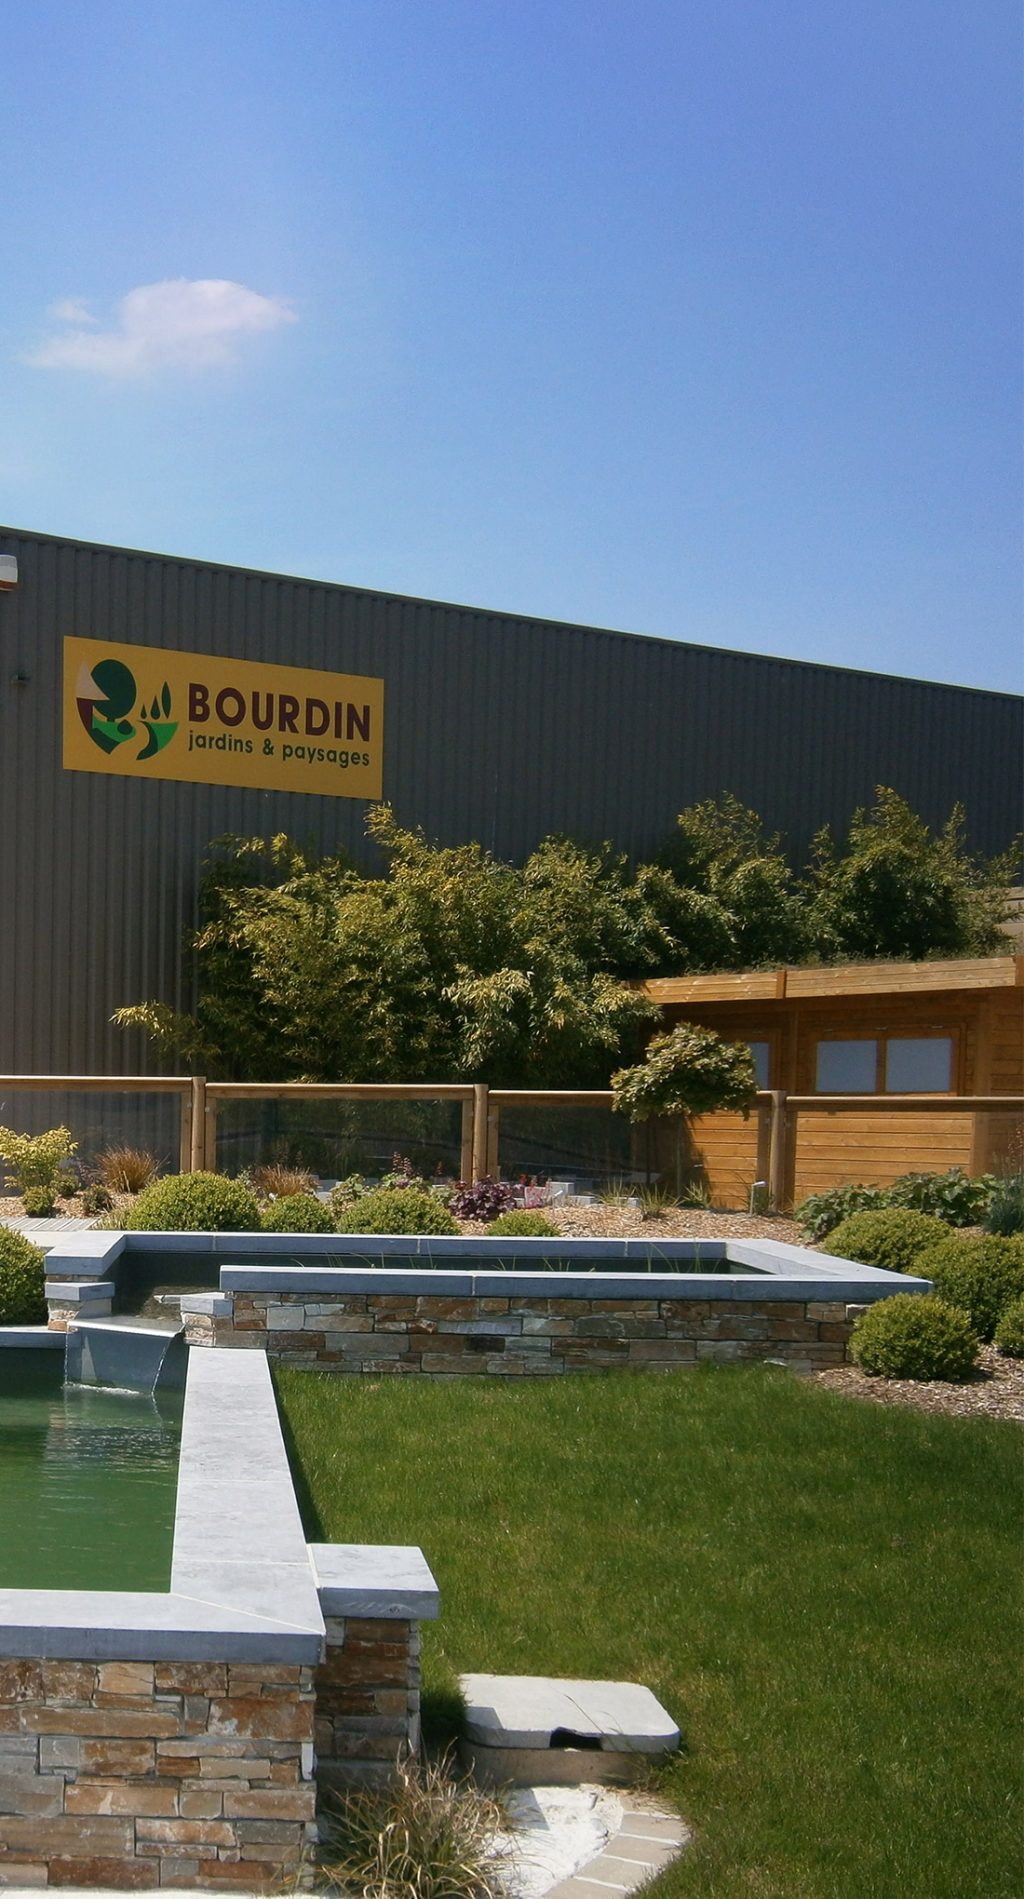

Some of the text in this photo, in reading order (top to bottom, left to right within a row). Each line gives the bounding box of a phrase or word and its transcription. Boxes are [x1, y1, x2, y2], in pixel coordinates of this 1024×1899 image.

[188, 682, 370, 742] BOURDIN
[188, 730, 370, 768] jardins & paysages
